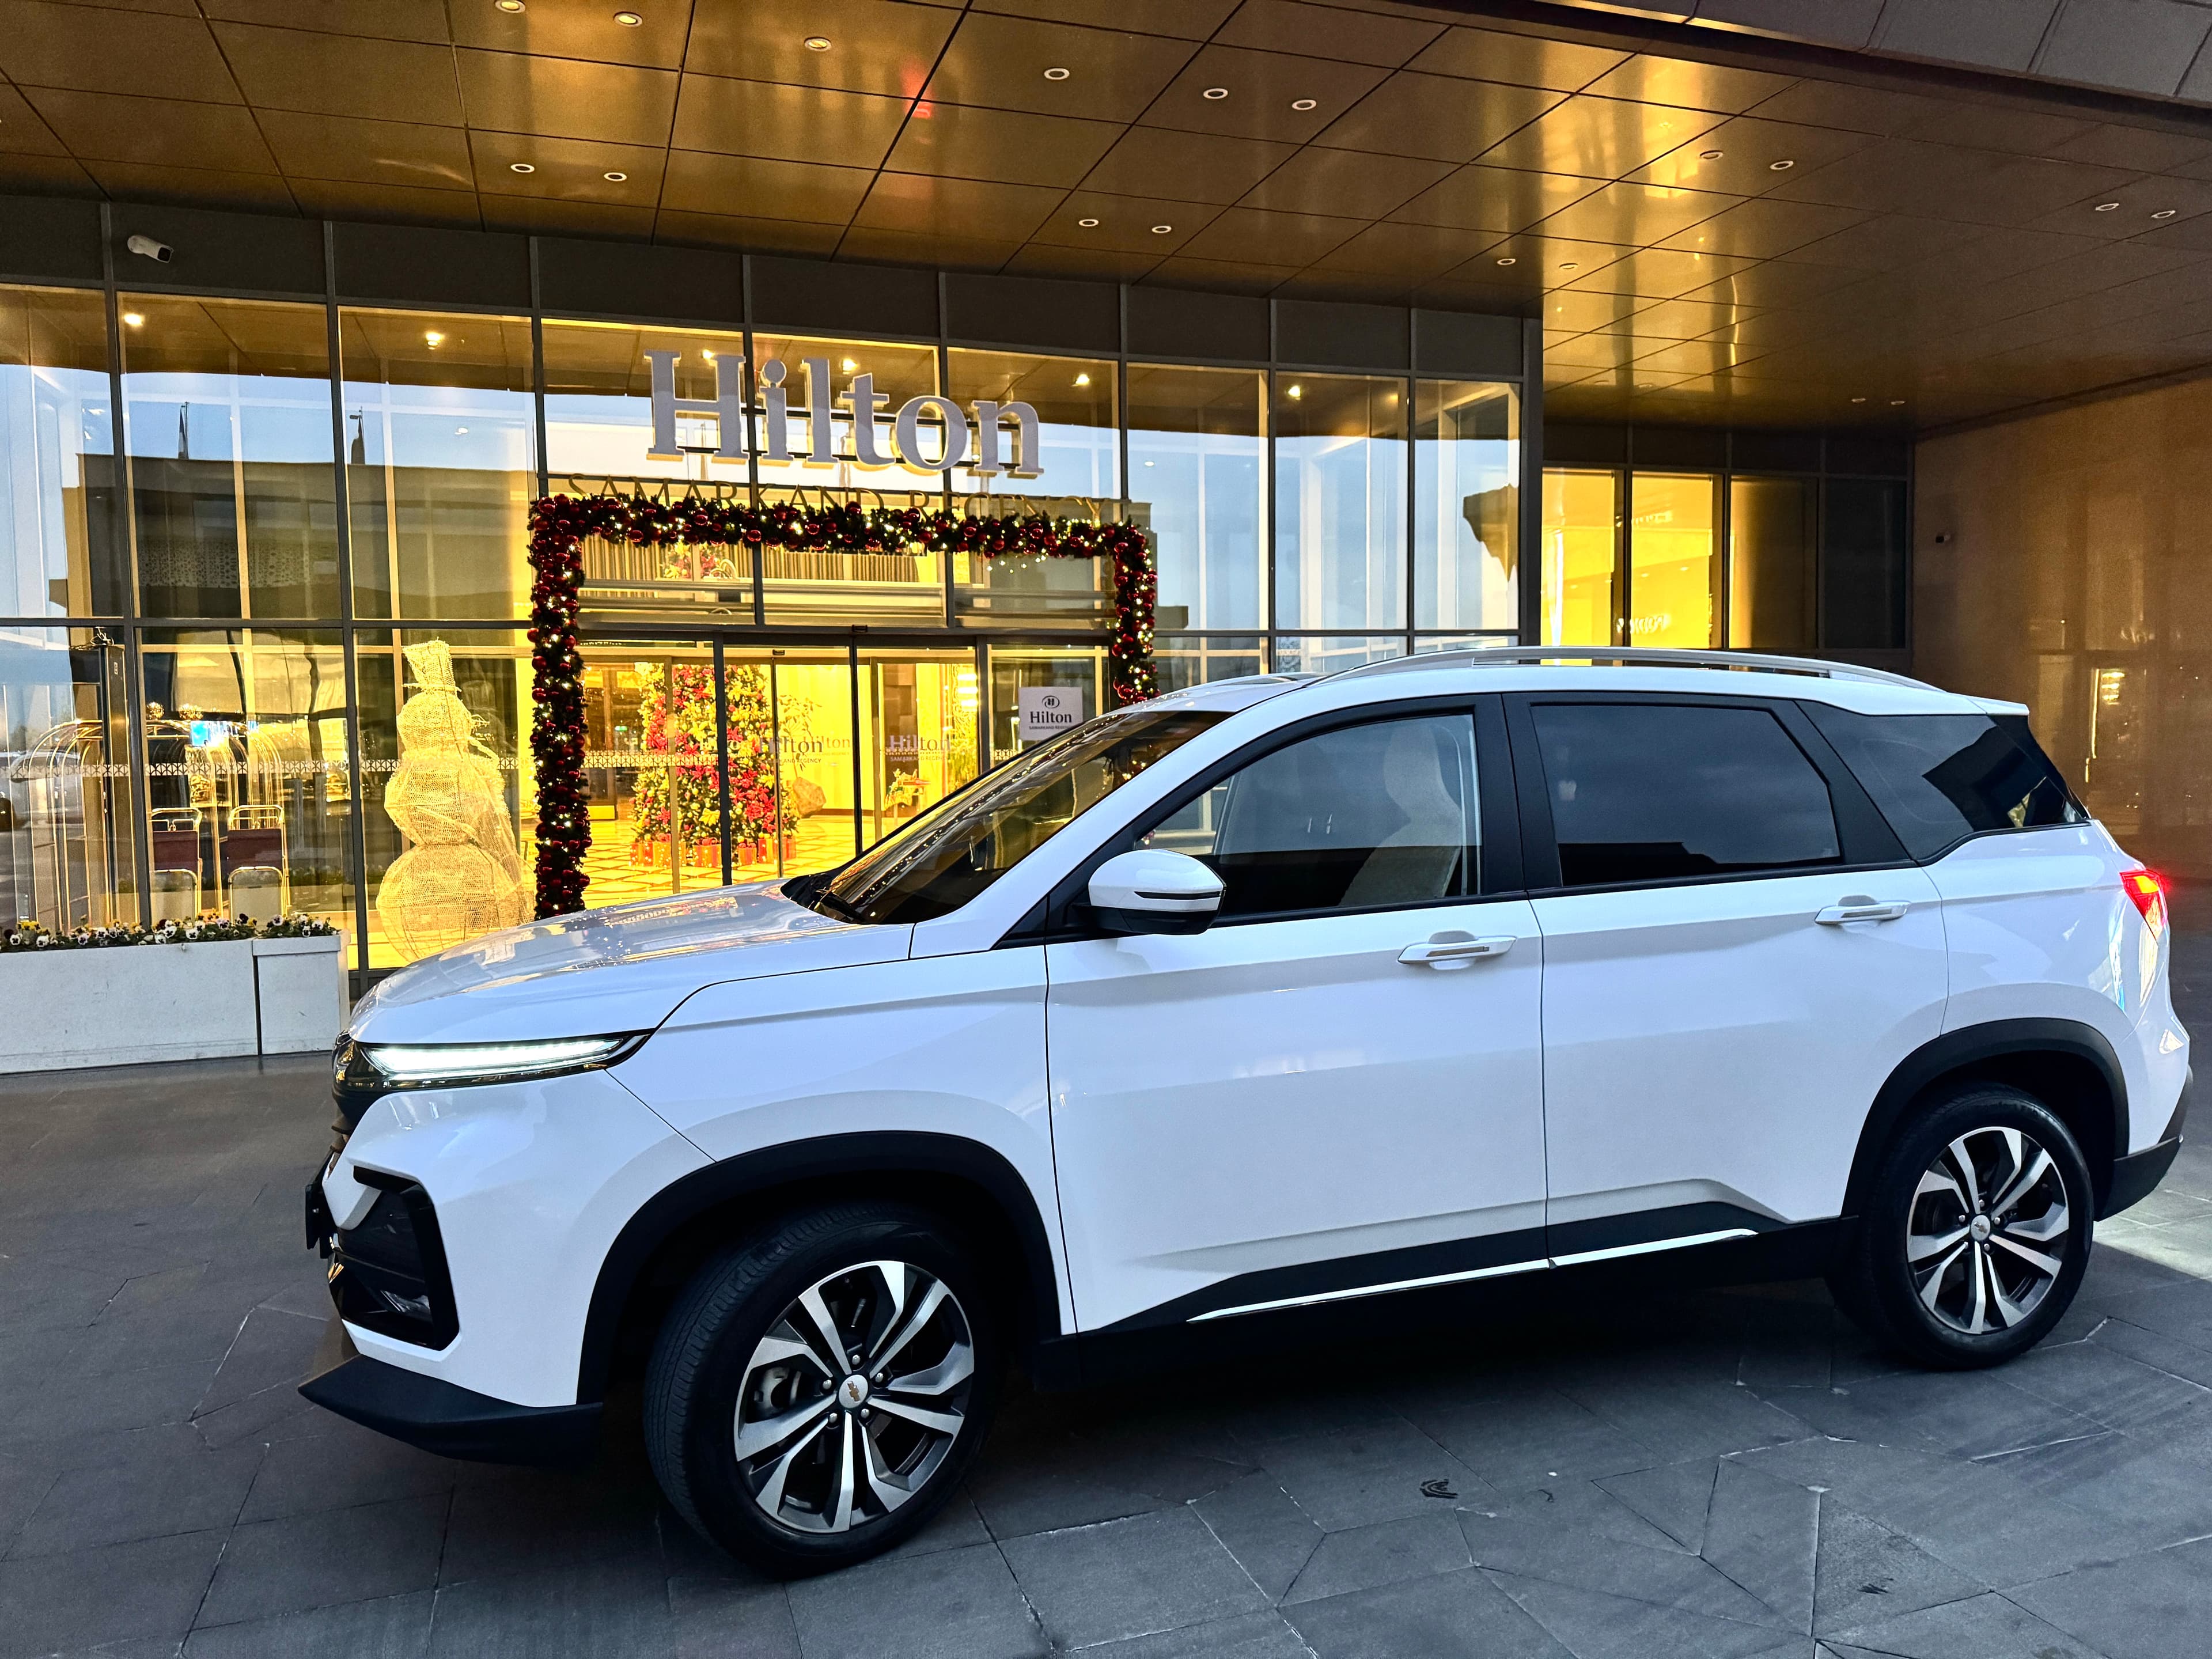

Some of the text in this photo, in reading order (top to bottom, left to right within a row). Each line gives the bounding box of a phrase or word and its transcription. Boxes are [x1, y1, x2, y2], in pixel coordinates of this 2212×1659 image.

[644, 350, 1044, 475] Hilton
[1030, 711, 1072, 724] Hilton
[889, 734, 950, 752] Hilton
